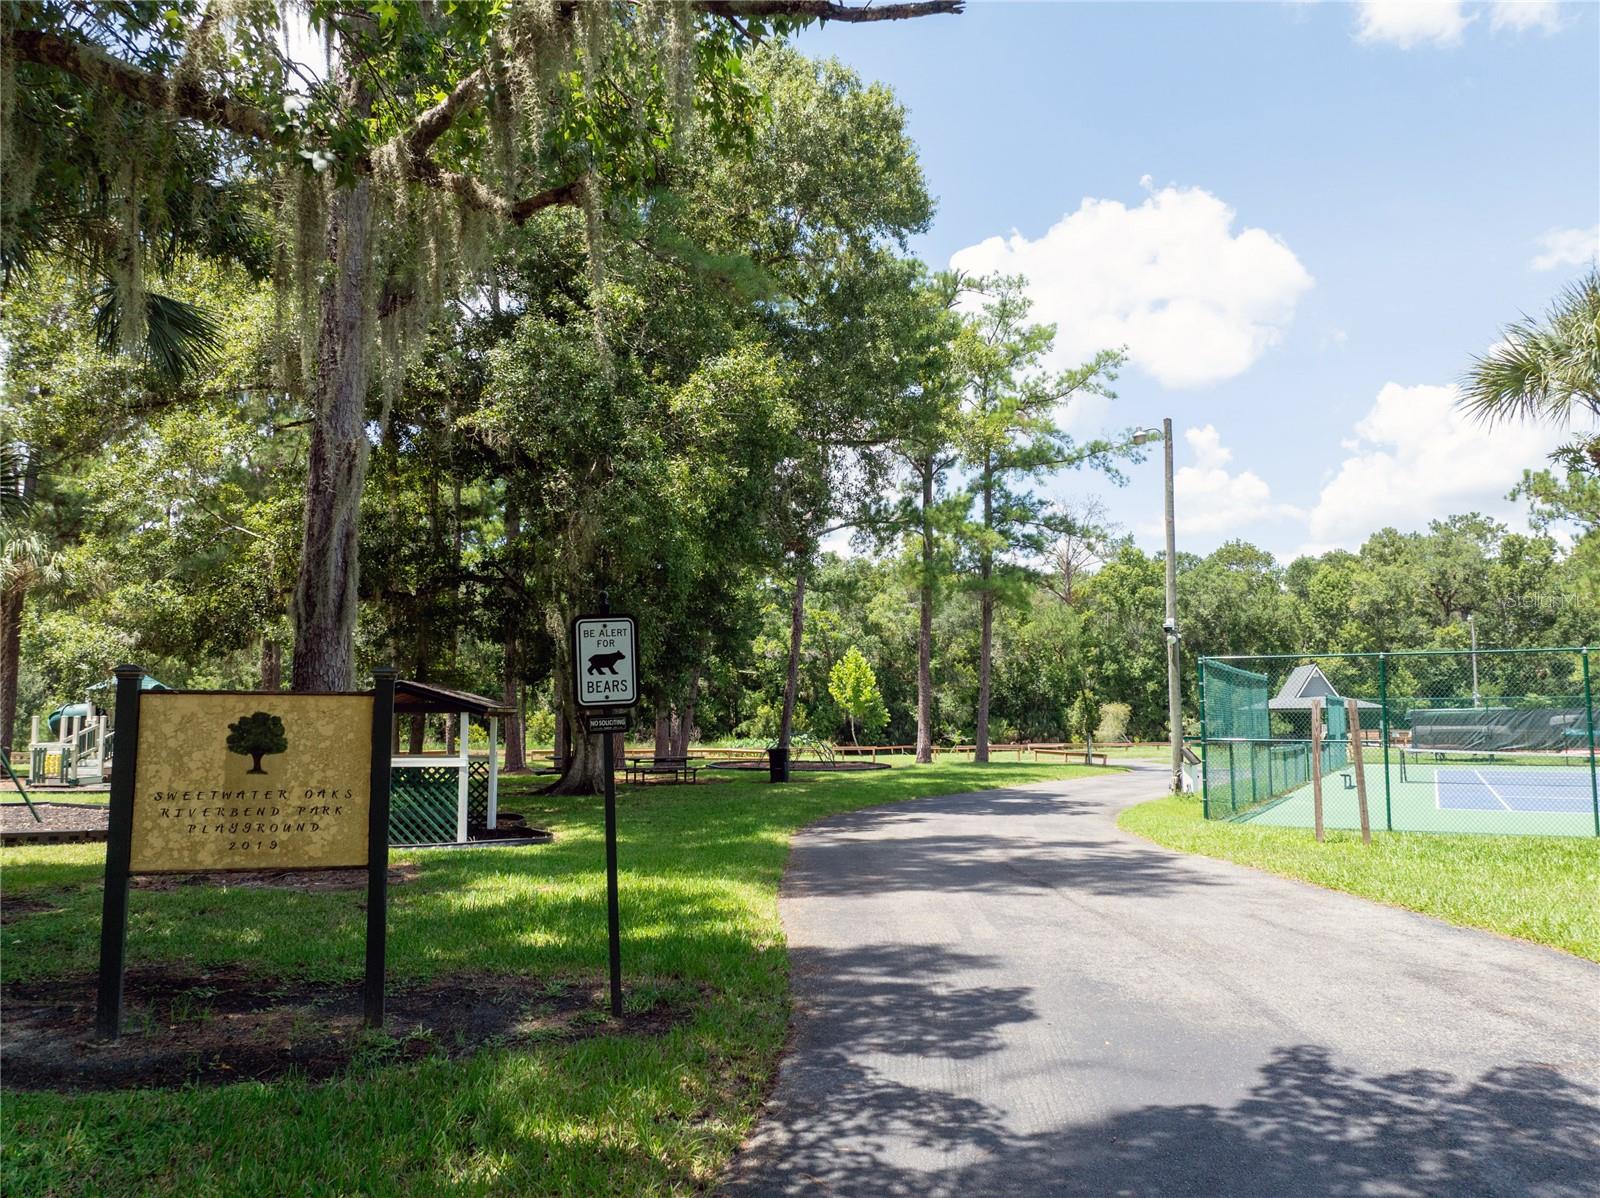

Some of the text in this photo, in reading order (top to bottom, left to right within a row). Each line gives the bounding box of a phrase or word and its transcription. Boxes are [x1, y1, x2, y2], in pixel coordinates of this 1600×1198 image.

[583, 628, 627, 638] BE ALERT
[597, 639, 615, 648] FOR
[587, 680, 628, 694] BEARS
[599, 719, 626, 727] SOLICITING
[154, 789, 353, 802] SWEETWATER OAKS
[160, 806, 343, 818] RIVERBEND PARK
[188, 823, 320, 834] PLAYGROUND
[228, 840, 278, 850] 2019
